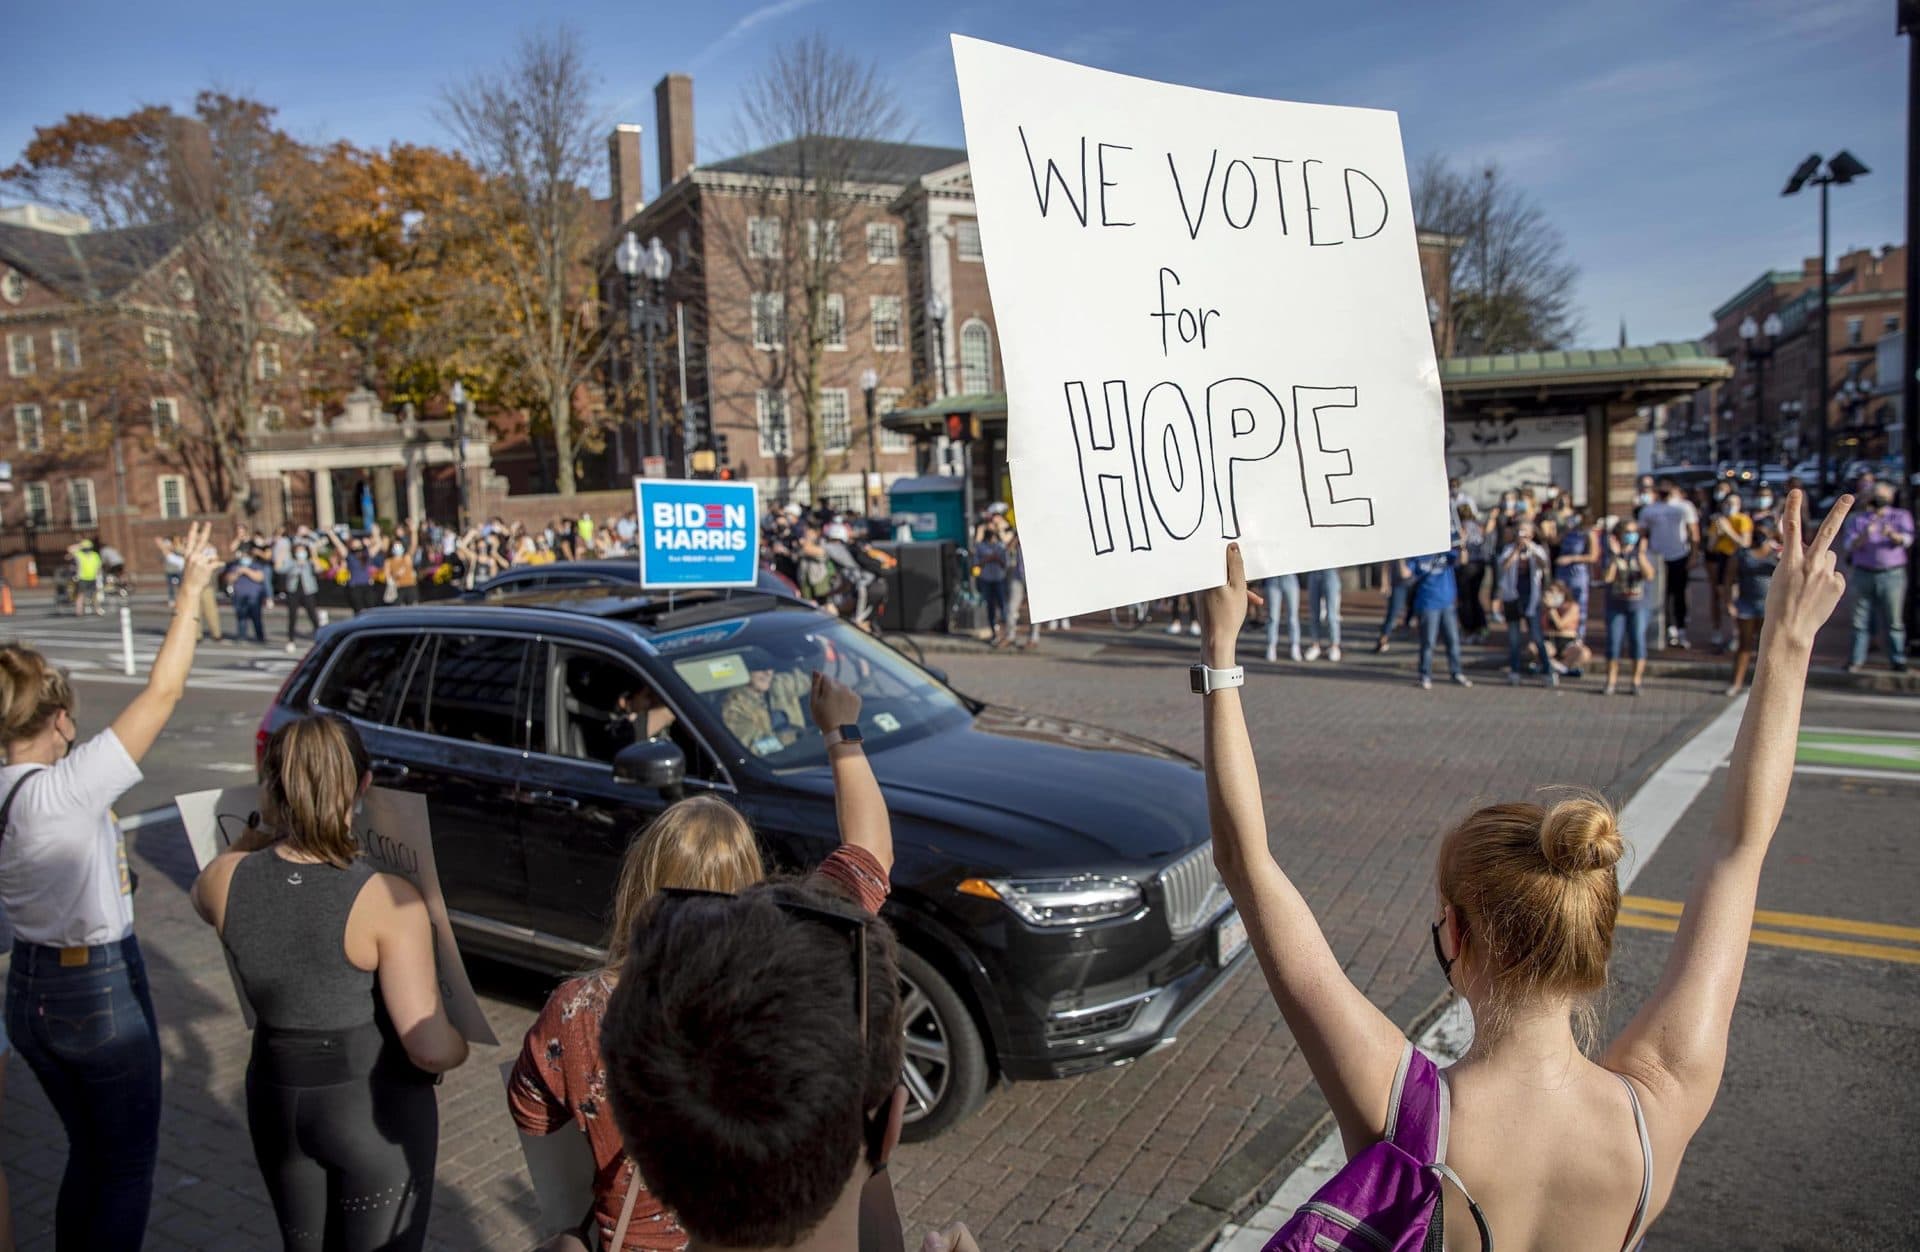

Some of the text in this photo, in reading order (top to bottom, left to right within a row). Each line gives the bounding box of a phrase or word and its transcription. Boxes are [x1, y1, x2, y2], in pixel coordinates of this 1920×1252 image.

[1018, 125, 1389, 247] WE VOTED
[1149, 267, 1221, 356] for
[1063, 377, 1375, 555] HOPE
[652, 502, 746, 529] BIDEN
[654, 528, 747, 551] HARRIS
